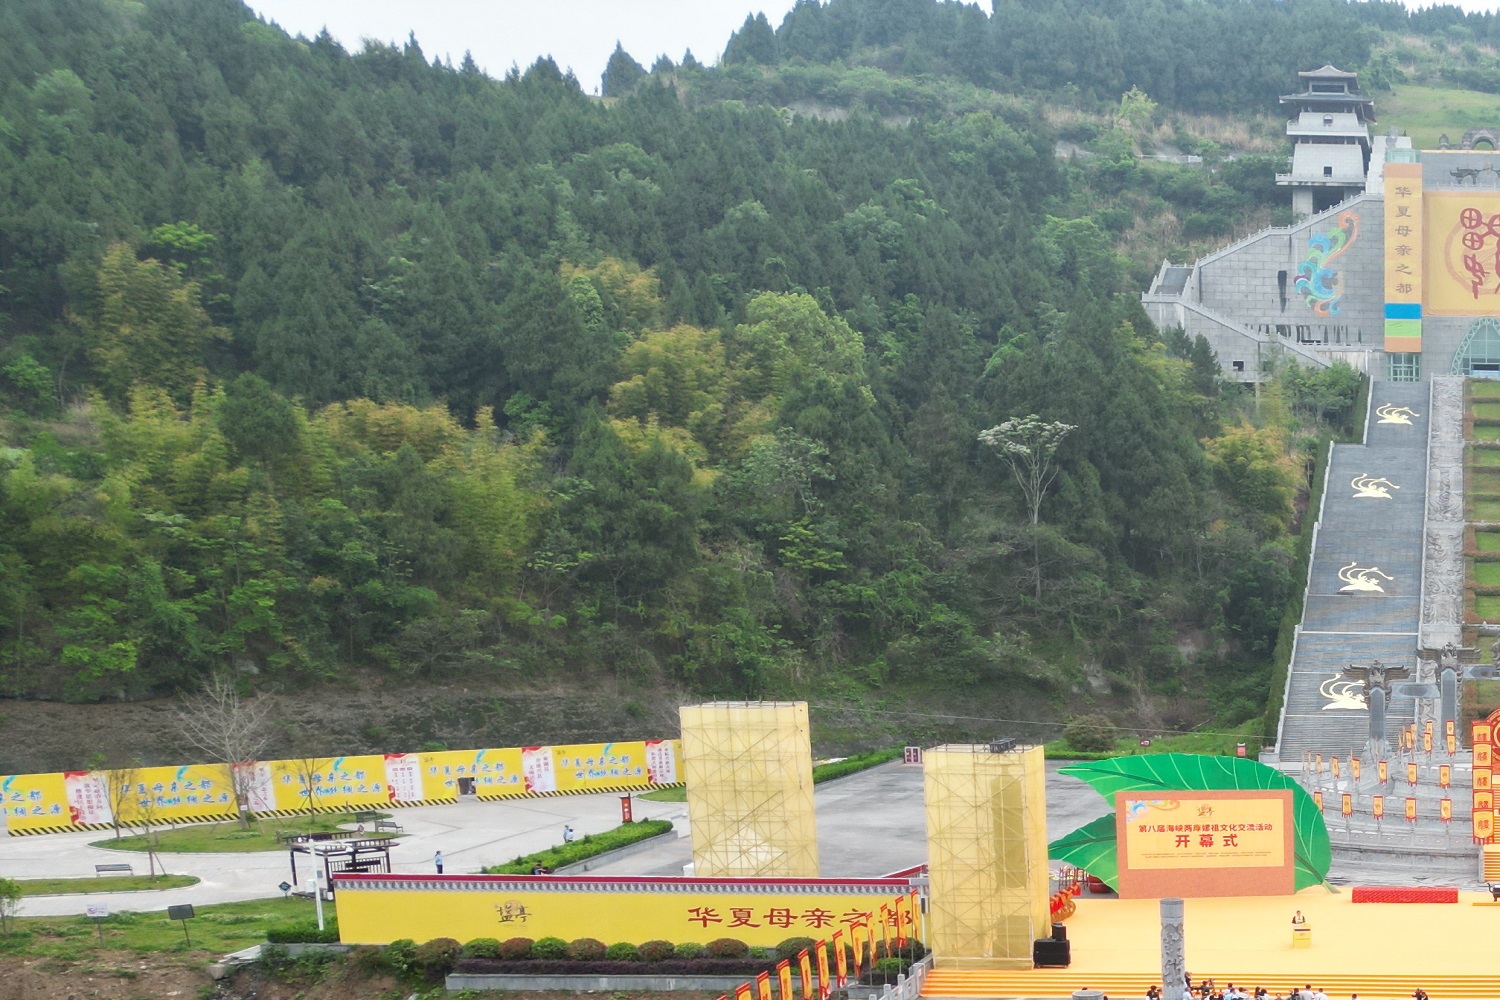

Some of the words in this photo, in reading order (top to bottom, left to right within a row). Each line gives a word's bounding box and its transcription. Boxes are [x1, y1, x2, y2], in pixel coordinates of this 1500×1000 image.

[1395, 186, 1412, 294] 华夏母亲之都
[1175, 833, 1238, 848] 开幕式
